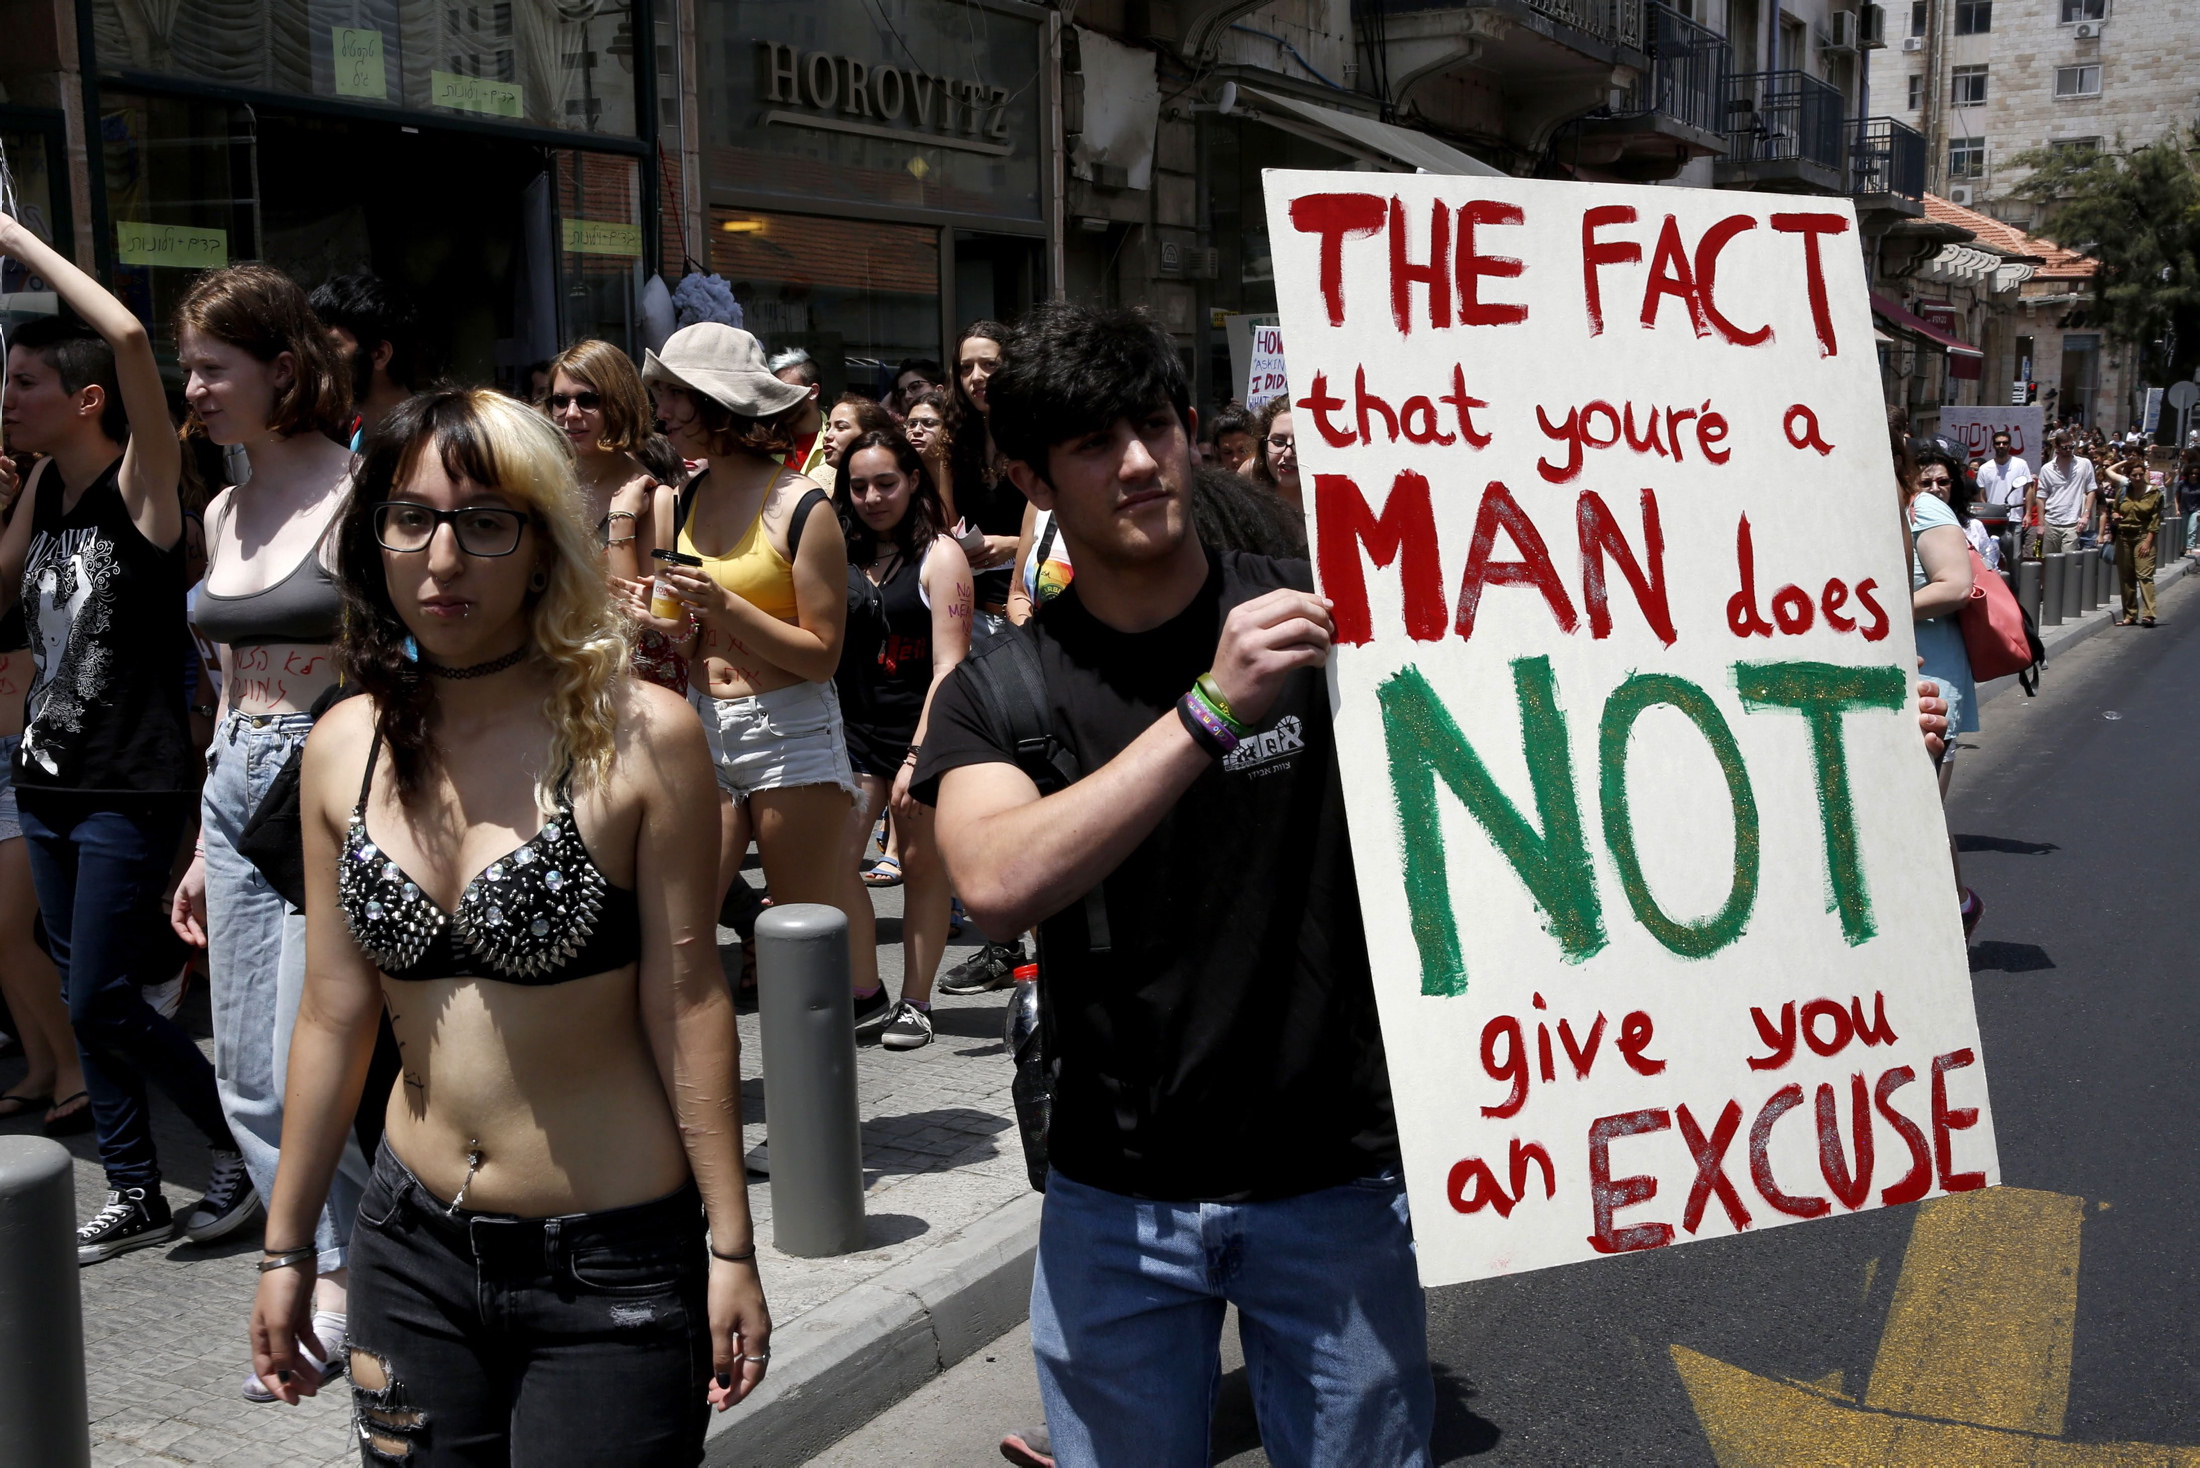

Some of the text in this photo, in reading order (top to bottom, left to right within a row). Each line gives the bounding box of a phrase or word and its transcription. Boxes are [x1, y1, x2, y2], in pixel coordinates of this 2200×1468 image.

[757, 40, 1010, 139] HOROVITZ
[1288, 192, 1850, 360] THE FACT
[1252, 376, 1262, 394] I
[1296, 362, 1492, 453] that
[1783, 403, 1836, 458] a
[1313, 468, 1891, 650] MAN does
[1247, 767, 1272, 781] אבידן
[1272, 761, 1291, 773] צוות
[1375, 654, 1907, 998] NOT
[1480, 991, 1898, 1119] give you
[1447, 1047, 1987, 1254] an EXCUSE
